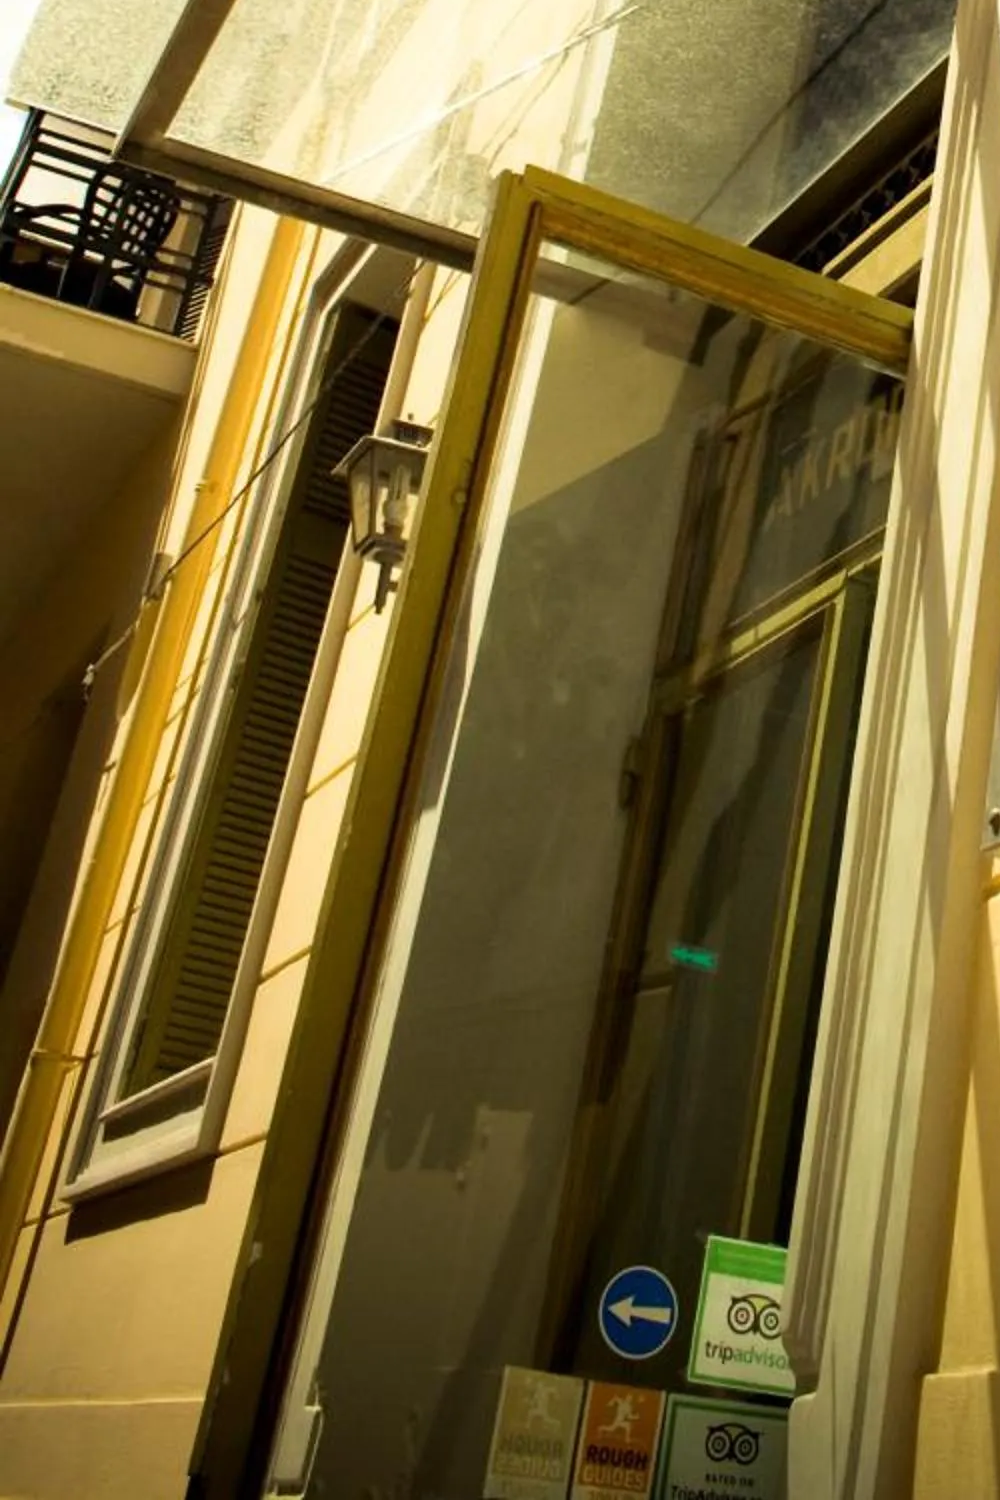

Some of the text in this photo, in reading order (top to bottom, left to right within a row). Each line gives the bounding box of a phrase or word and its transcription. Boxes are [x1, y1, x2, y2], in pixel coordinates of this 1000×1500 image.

[705, 1340, 789, 1370] tripadviso
[586, 1443, 648, 1471] ROUGH
[582, 1464, 645, 1489] GUIDES
